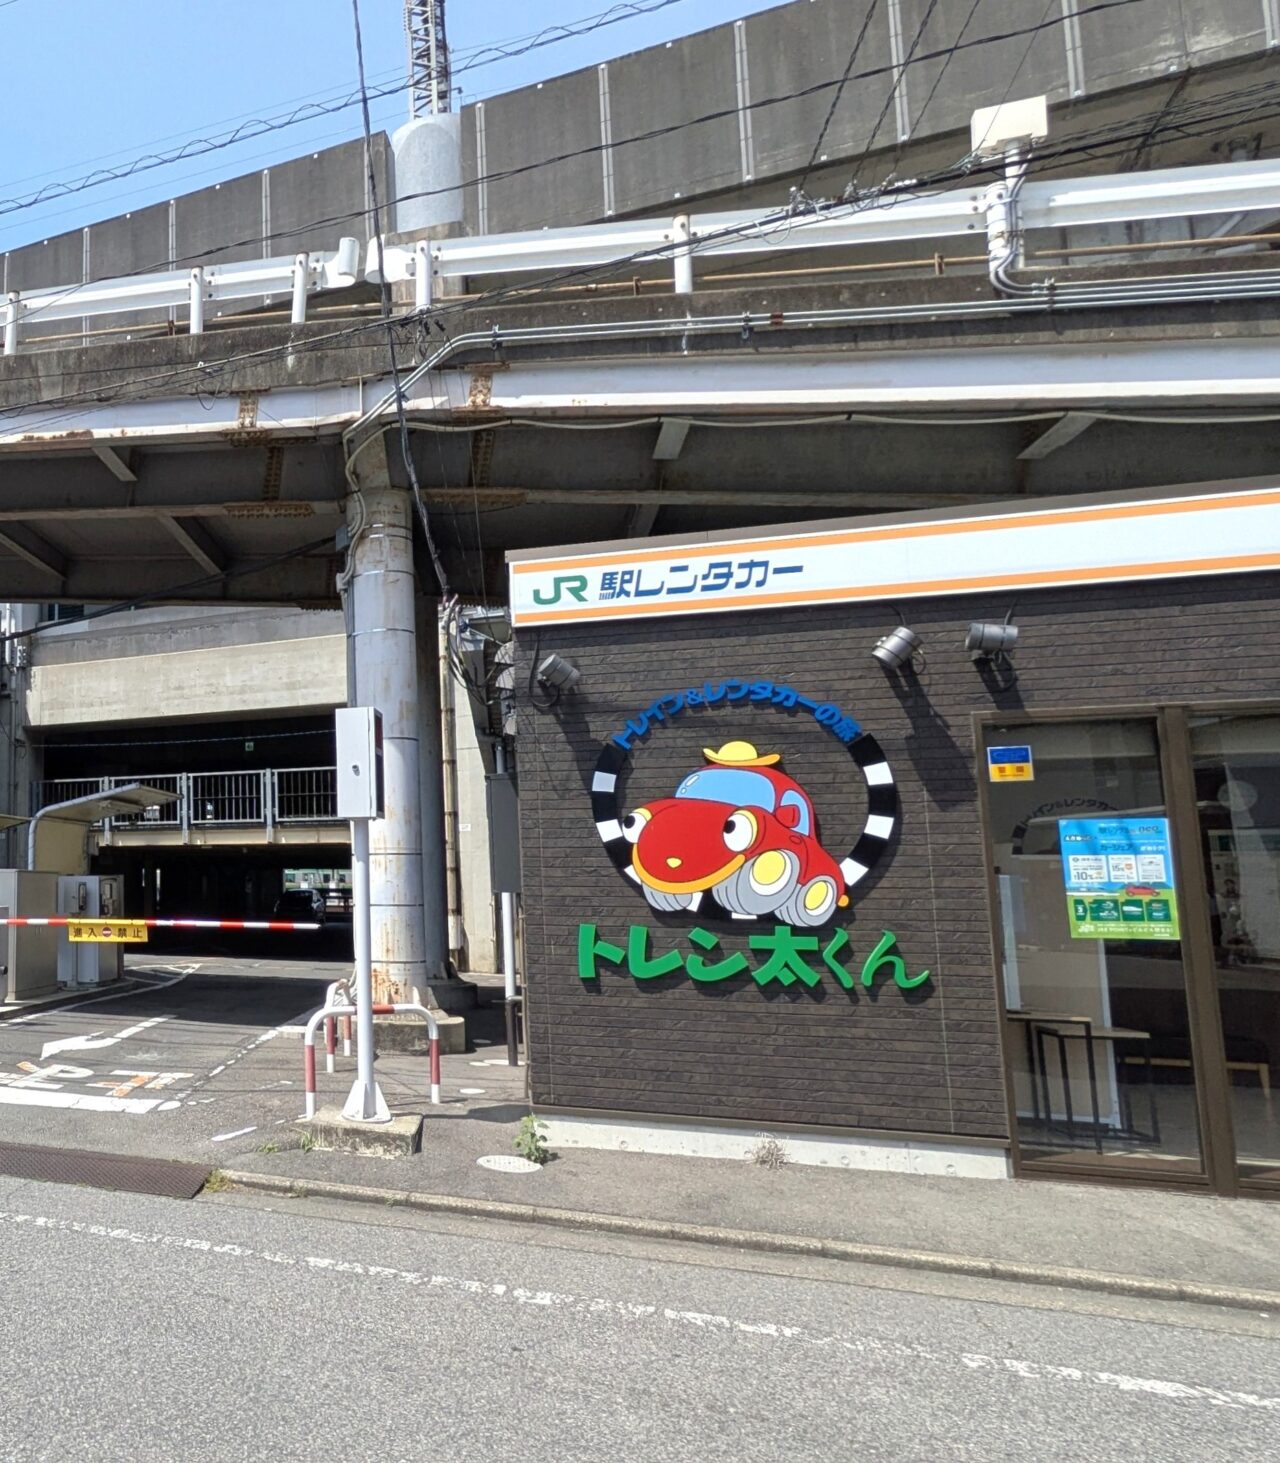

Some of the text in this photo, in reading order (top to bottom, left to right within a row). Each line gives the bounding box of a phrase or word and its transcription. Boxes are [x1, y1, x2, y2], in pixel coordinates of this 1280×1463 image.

[532, 559, 804, 606] JR 駅レンタカー
[611, 677, 864, 750] トレイン&レンタカーの旅
[72, 926, 145, 939] 進入 禁止
[577, 922, 931, 990] トレン太くん
